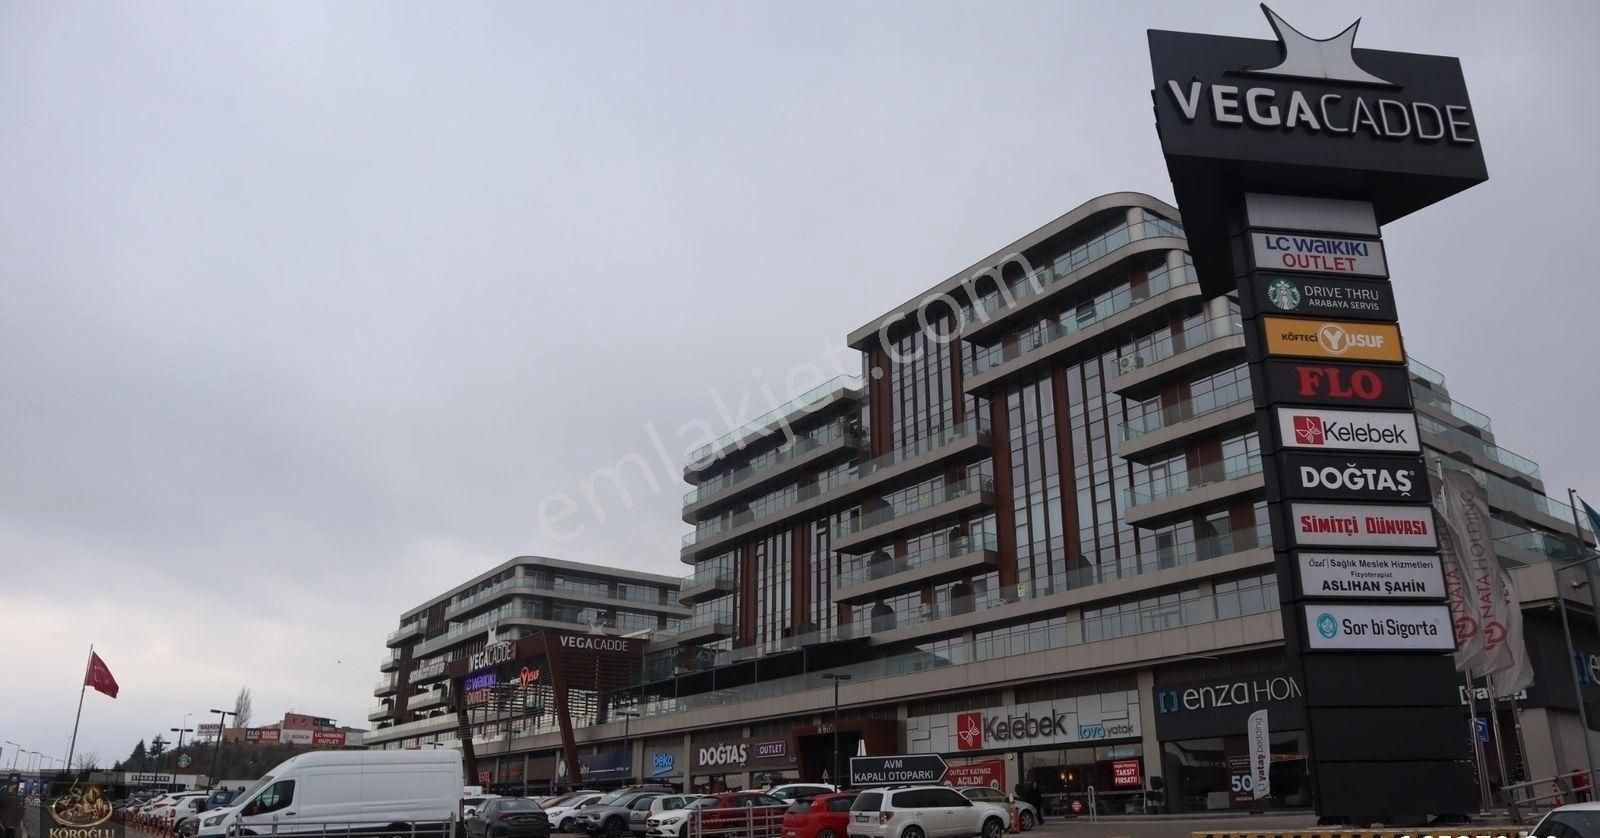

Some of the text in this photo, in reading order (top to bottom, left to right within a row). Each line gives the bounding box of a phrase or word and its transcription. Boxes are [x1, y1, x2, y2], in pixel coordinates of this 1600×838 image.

[1167, 79, 1476, 143] VEGACADDE
[1265, 235, 1291, 252] LC
[1282, 252, 1357, 272] OUTLET
[1304, 285, 1379, 301] DRIVE THRU
[1309, 298, 1349, 310] ARABAYA
[1281, 327, 1384, 351] KÖFTECİ YUSUF
[1296, 366, 1383, 400] FLO
[1322, 421, 1408, 444] Kelebek
[1300, 462, 1409, 497] DOĞTAŞ
[1308, 557, 1434, 570] Özel Sağlık Meslek Hizmetleri
[1460, 488, 1494, 619] NATA HOLDING
[1350, 570, 1393, 579] Fizyoterapist
[1322, 579, 1426, 595] ASLIHAN ŞAHİN
[1342, 618, 1438, 639] Sor bi Sigorta
[560, 635, 629, 652] VEGACADDE
[468, 641, 513, 673] VEGACADDE
[1182, 681, 1250, 710] enza
[983, 708, 1068, 742] Kelebek
[1106, 723, 1134, 736] yatak
[653, 752, 674, 767] beko
[699, 742, 783, 767] DOĞTAŞ OUTLET
[883, 759, 903, 769] AVM
[854, 770, 934, 782] KAPALI OTOPARKI
[1231, 775, 1254, 792] 50
